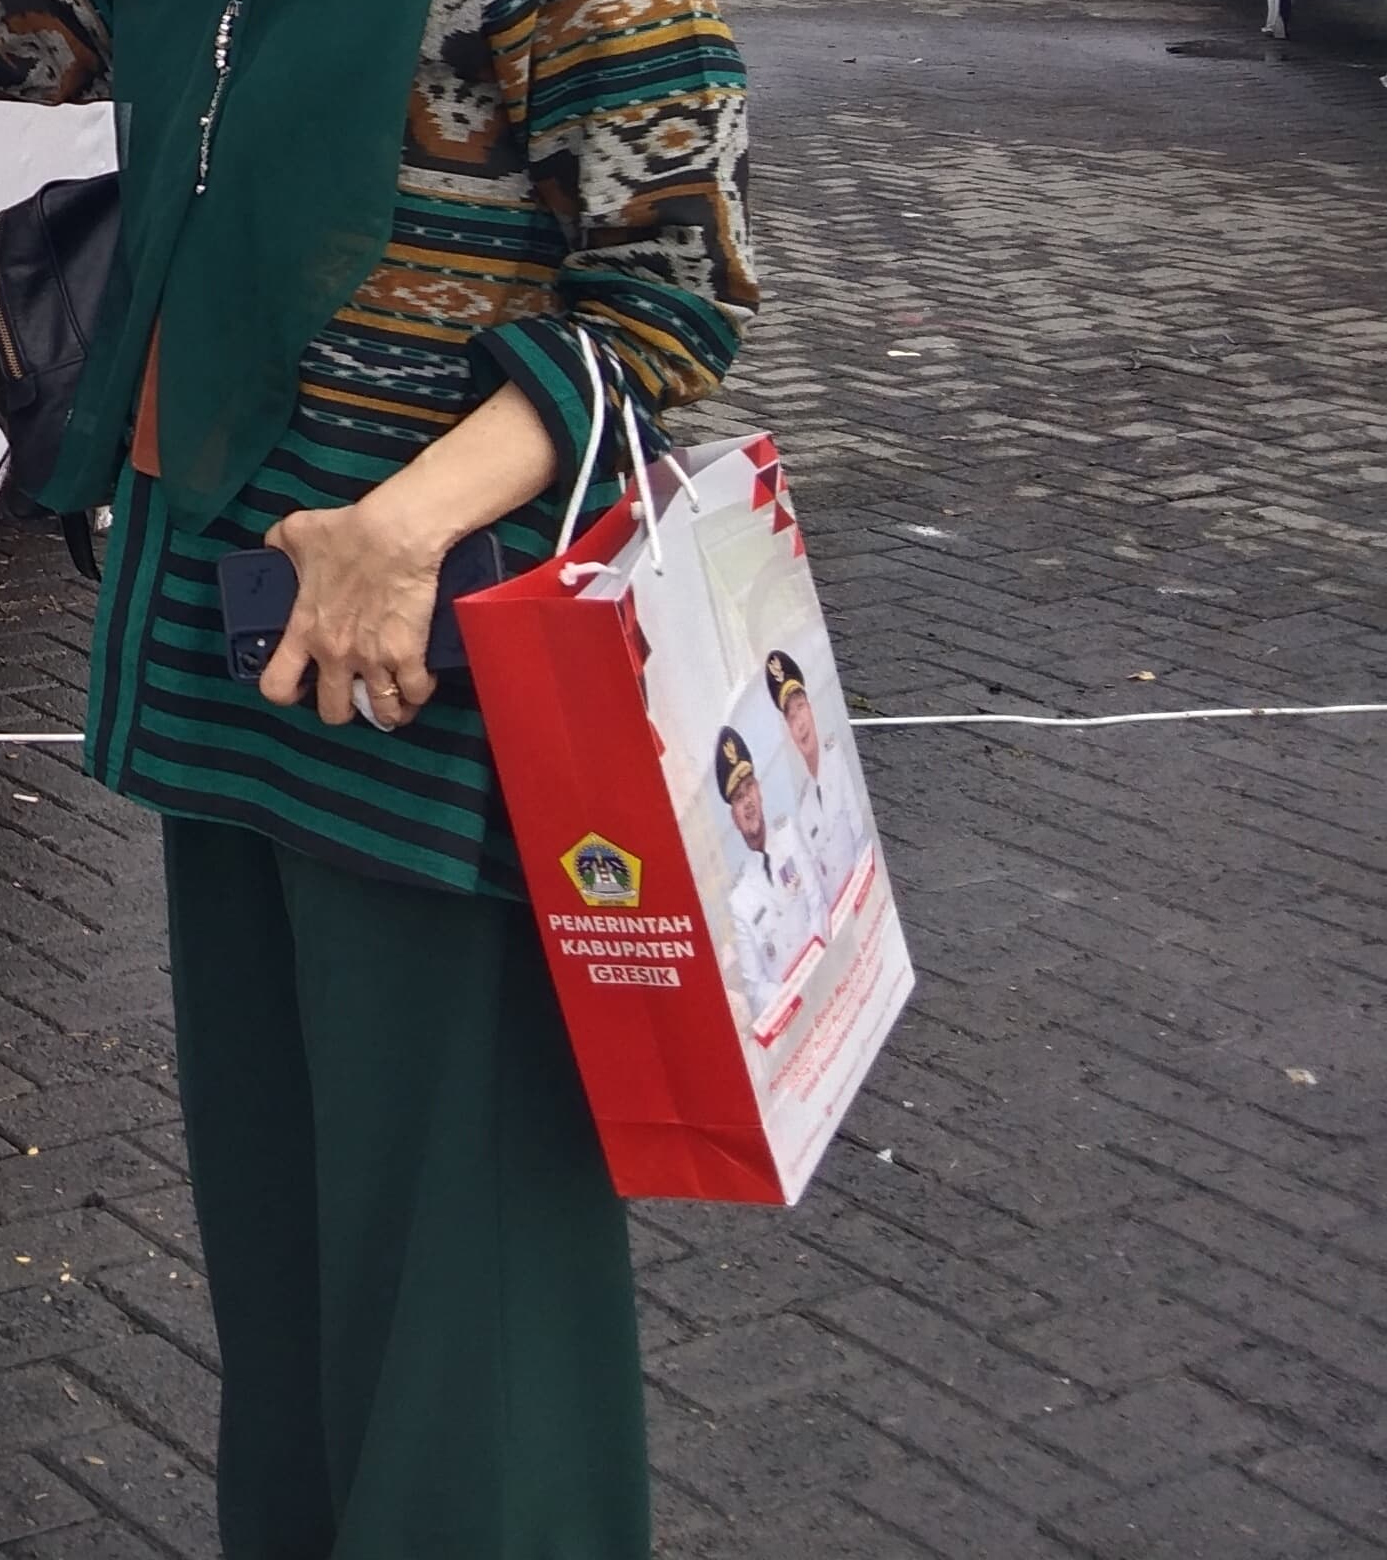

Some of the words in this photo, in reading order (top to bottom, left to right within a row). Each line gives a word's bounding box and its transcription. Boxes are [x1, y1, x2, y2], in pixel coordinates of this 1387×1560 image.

[548, 914, 693, 934] PEMERINTAH
[560, 939, 695, 958] KABUPATEN
[594, 966, 674, 984] GRESIK
